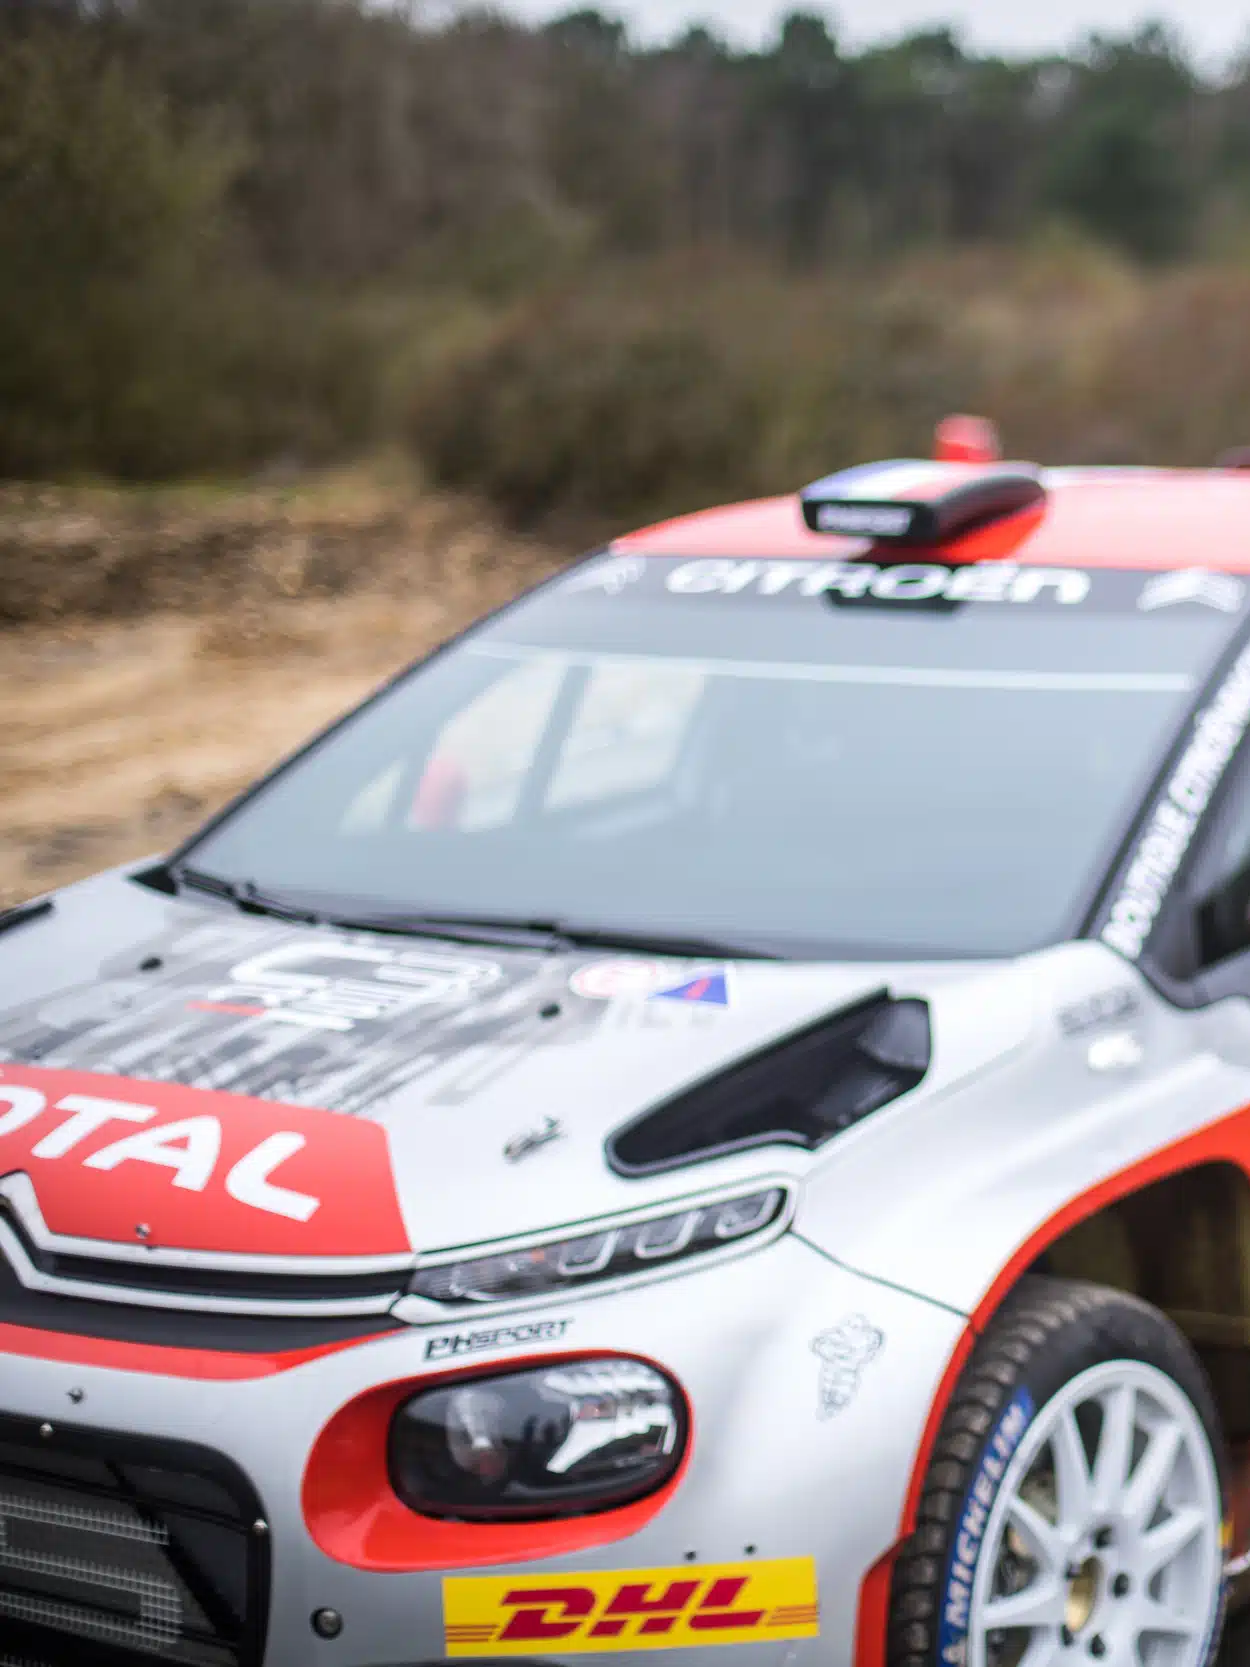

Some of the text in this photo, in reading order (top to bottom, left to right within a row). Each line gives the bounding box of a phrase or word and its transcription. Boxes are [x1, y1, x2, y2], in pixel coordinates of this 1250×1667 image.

[0, 1083, 321, 1223] OTAL
[423, 1319, 574, 1361] PHSPORT
[943, 1401, 1028, 1629] MICHELIN
[497, 1576, 766, 1641] DHL
